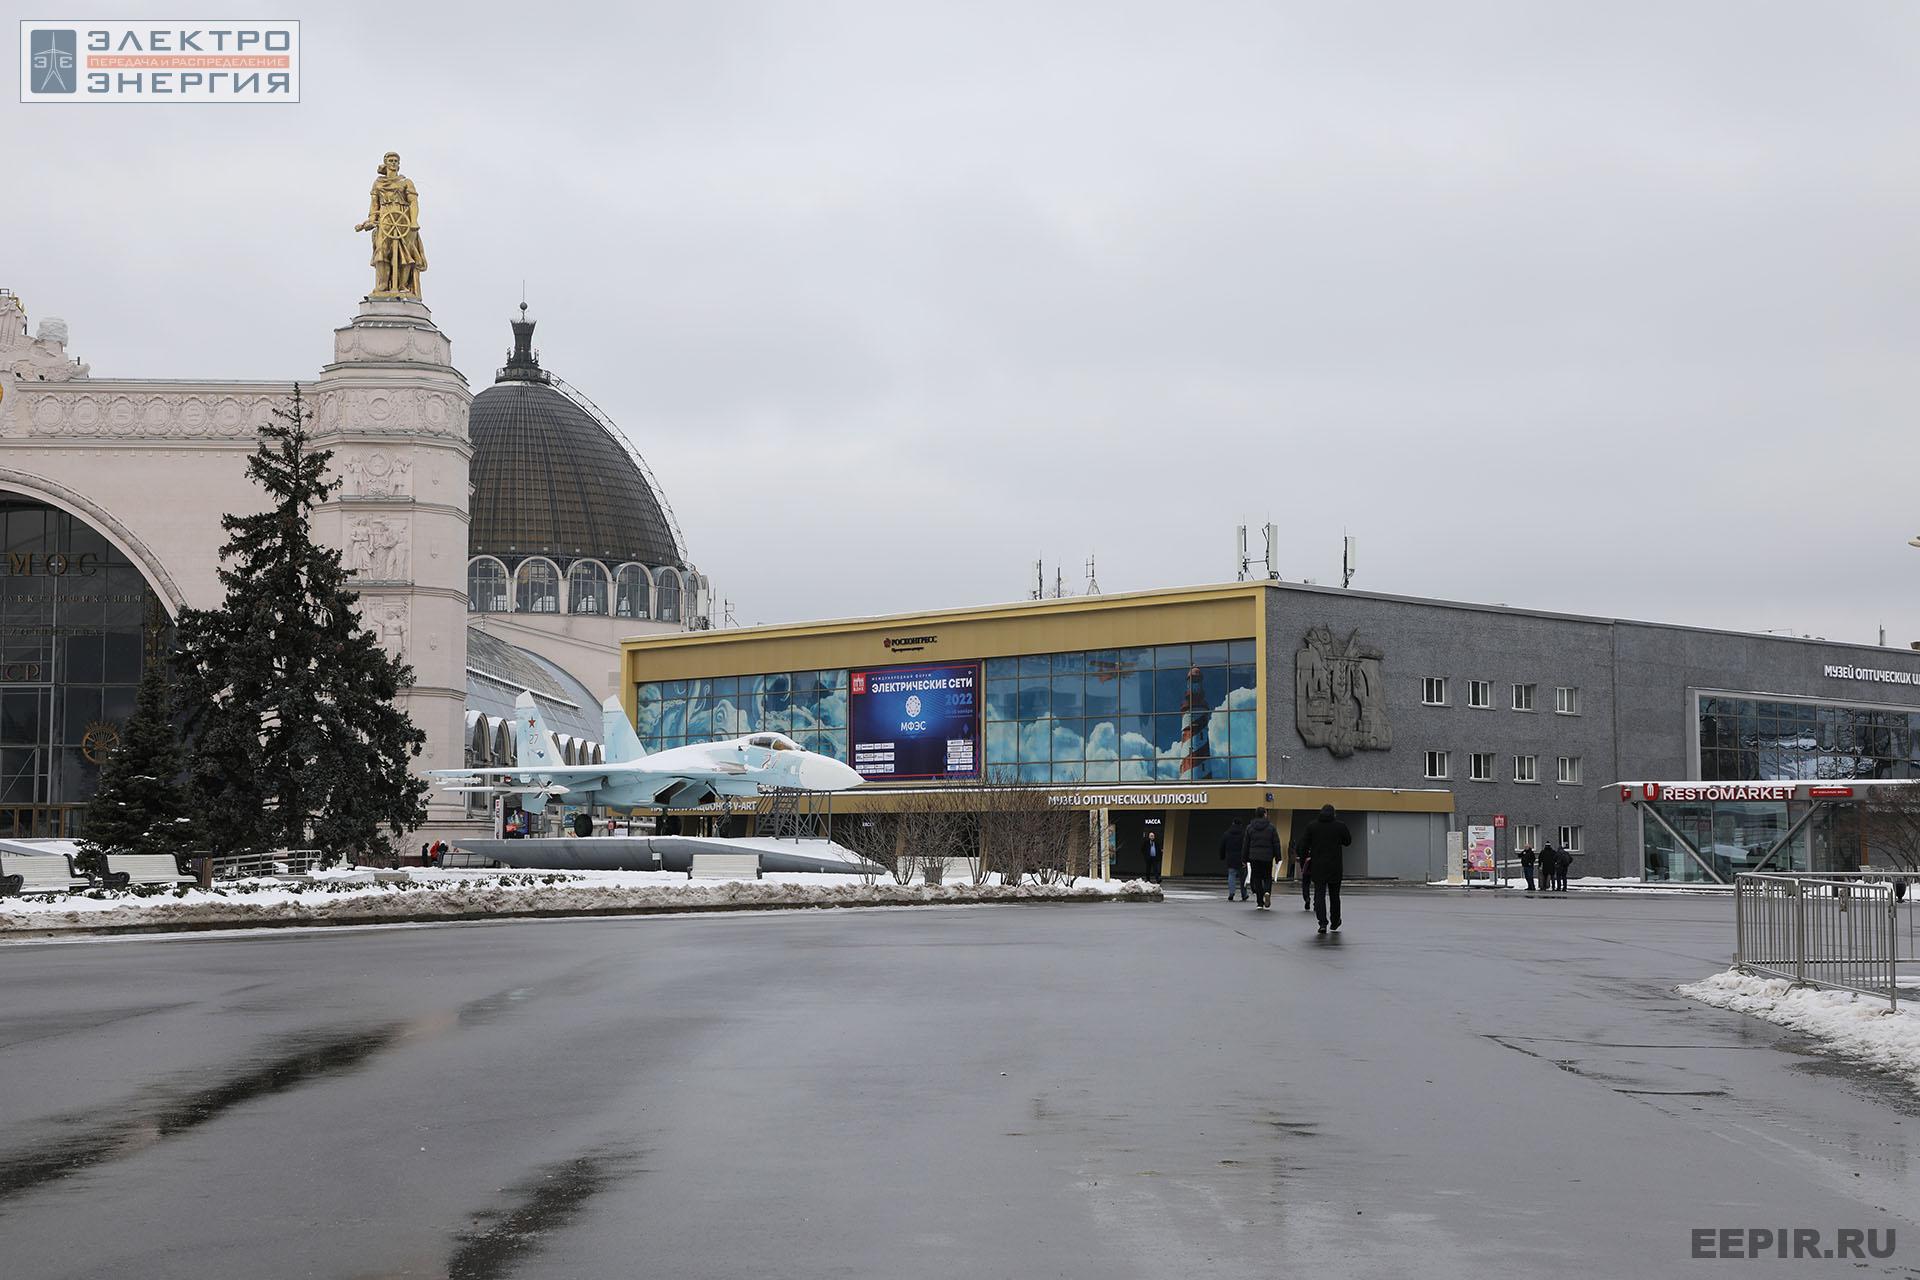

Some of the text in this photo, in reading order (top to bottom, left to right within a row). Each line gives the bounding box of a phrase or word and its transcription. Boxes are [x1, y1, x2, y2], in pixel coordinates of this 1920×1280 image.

[891, 635, 938, 646] РОСКОНГРЕСС
[1823, 664, 1920, 685] МУЗЕЙ ОПТИЧЕСКИХ И
[871, 677, 973, 694] ЭЛЕКТРИЧЕСКИЕ СЕТИ
[945, 693, 973, 706] 2022
[900, 720, 927, 732] МФЭС
[1048, 791, 1208, 806] МУЗЕЙ ОПТИЧЕСКИХ ИЛЛЮЗИЙ
[1663, 787, 1795, 800] RESTOMARKET
[733, 801, 757, 811] V-ART
